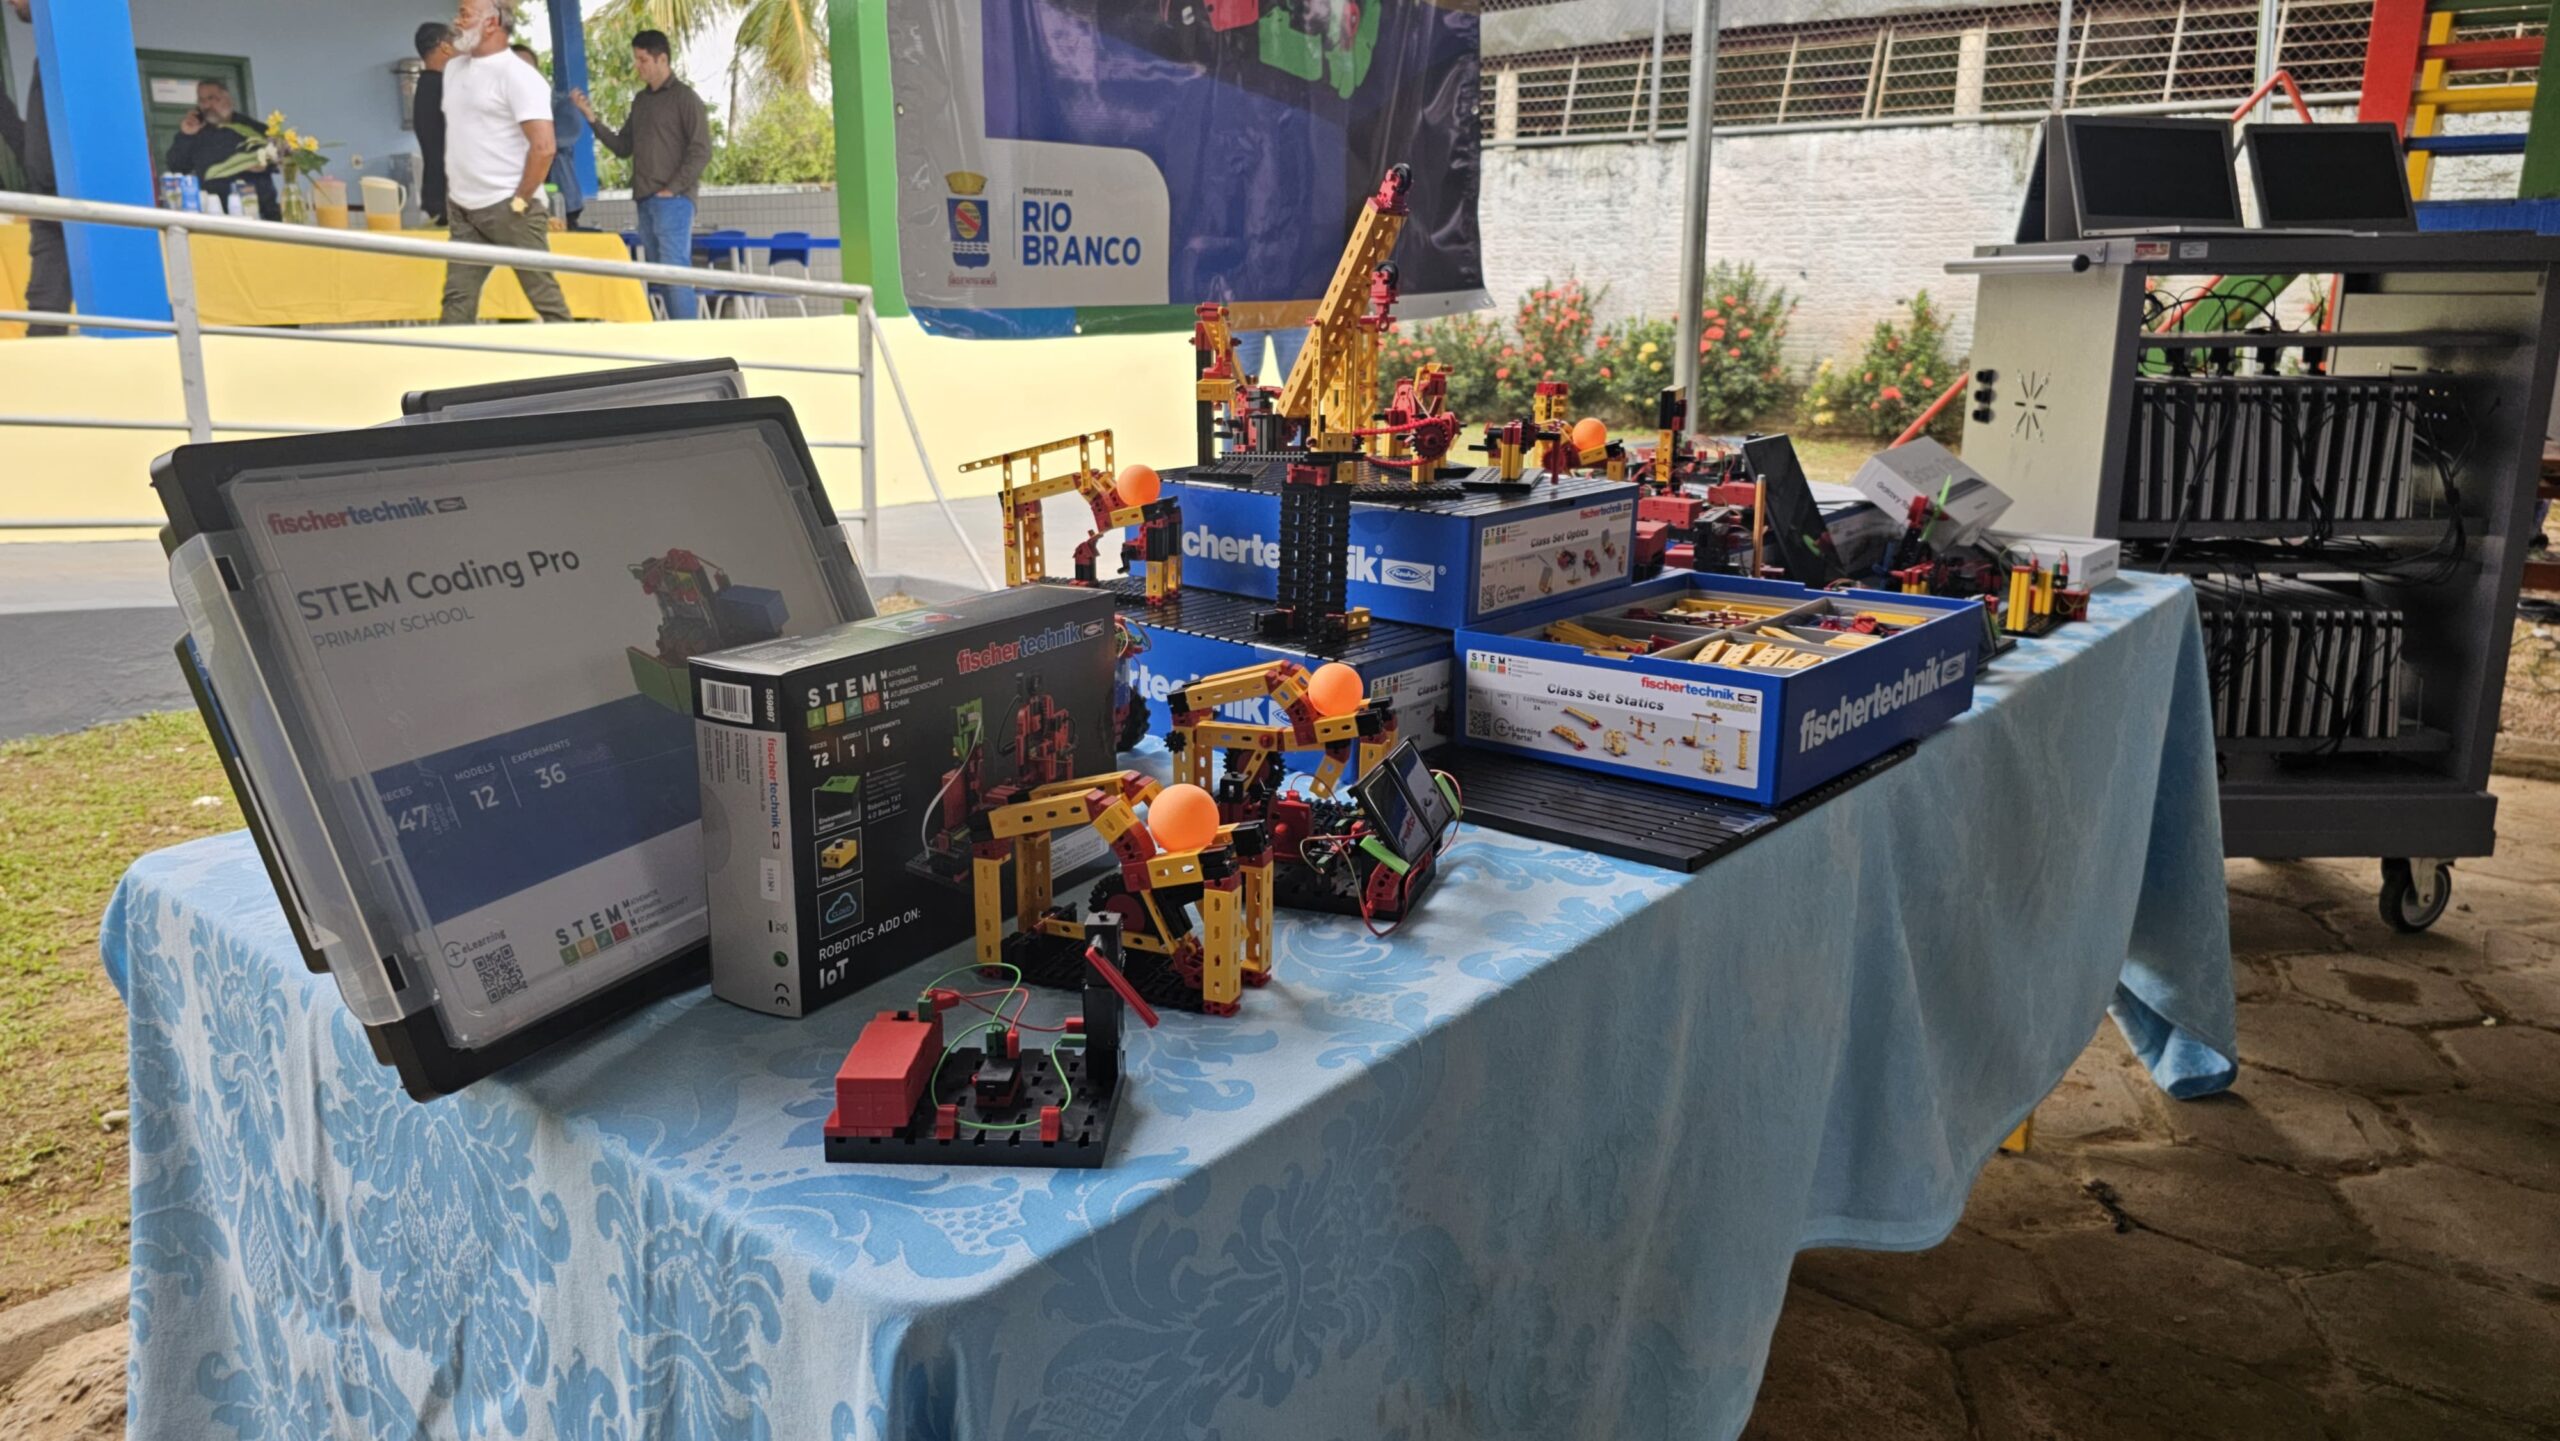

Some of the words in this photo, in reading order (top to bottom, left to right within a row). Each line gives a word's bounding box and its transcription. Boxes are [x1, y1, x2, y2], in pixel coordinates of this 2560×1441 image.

[1063, 189, 1073, 197] DE
[1022, 201, 1072, 233] RIO
[1022, 235, 1141, 266] BRANCO
[267, 496, 433, 536] fischertechnik
[297, 576, 402, 621] STEM
[406, 559, 525, 600] Coding
[527, 550, 580, 577] Pro
[313, 619, 396, 650] PRIMARY
[400, 606, 475, 633] SCHOOL
[957, 622, 1081, 674] fischertechnik
[1471, 652, 1507, 665] STEM
[808, 673, 878, 708] STEM
[1374, 675, 1398, 689] STEM
[1640, 676, 1735, 701] fischertechnik
[1547, 683, 1584, 700] Class
[1587, 690, 1611, 704] Set
[1615, 692, 1664, 711] Statics
[1705, 699, 1757, 714] education
[1800, 656, 1940, 753] fischertechnik
[511, 738, 571, 765] EXPERIMENTS
[850, 744, 856, 757] 1
[882, 734, 890, 747] 6
[454, 762, 495, 782] MODELS
[813, 752, 830, 768] 72
[535, 763, 567, 789] 36
[767, 738, 781, 828] fischertechnik
[380, 785, 414, 803] IECES
[470, 785, 500, 810] 12
[555, 904, 622, 946] STEM
[819, 927, 875, 961] ROBOTICS
[877, 916, 900, 936] ADD
[903, 908, 921, 924] ON:
[461, 928, 507, 954] eLearning
[819, 958, 849, 989] IoT
